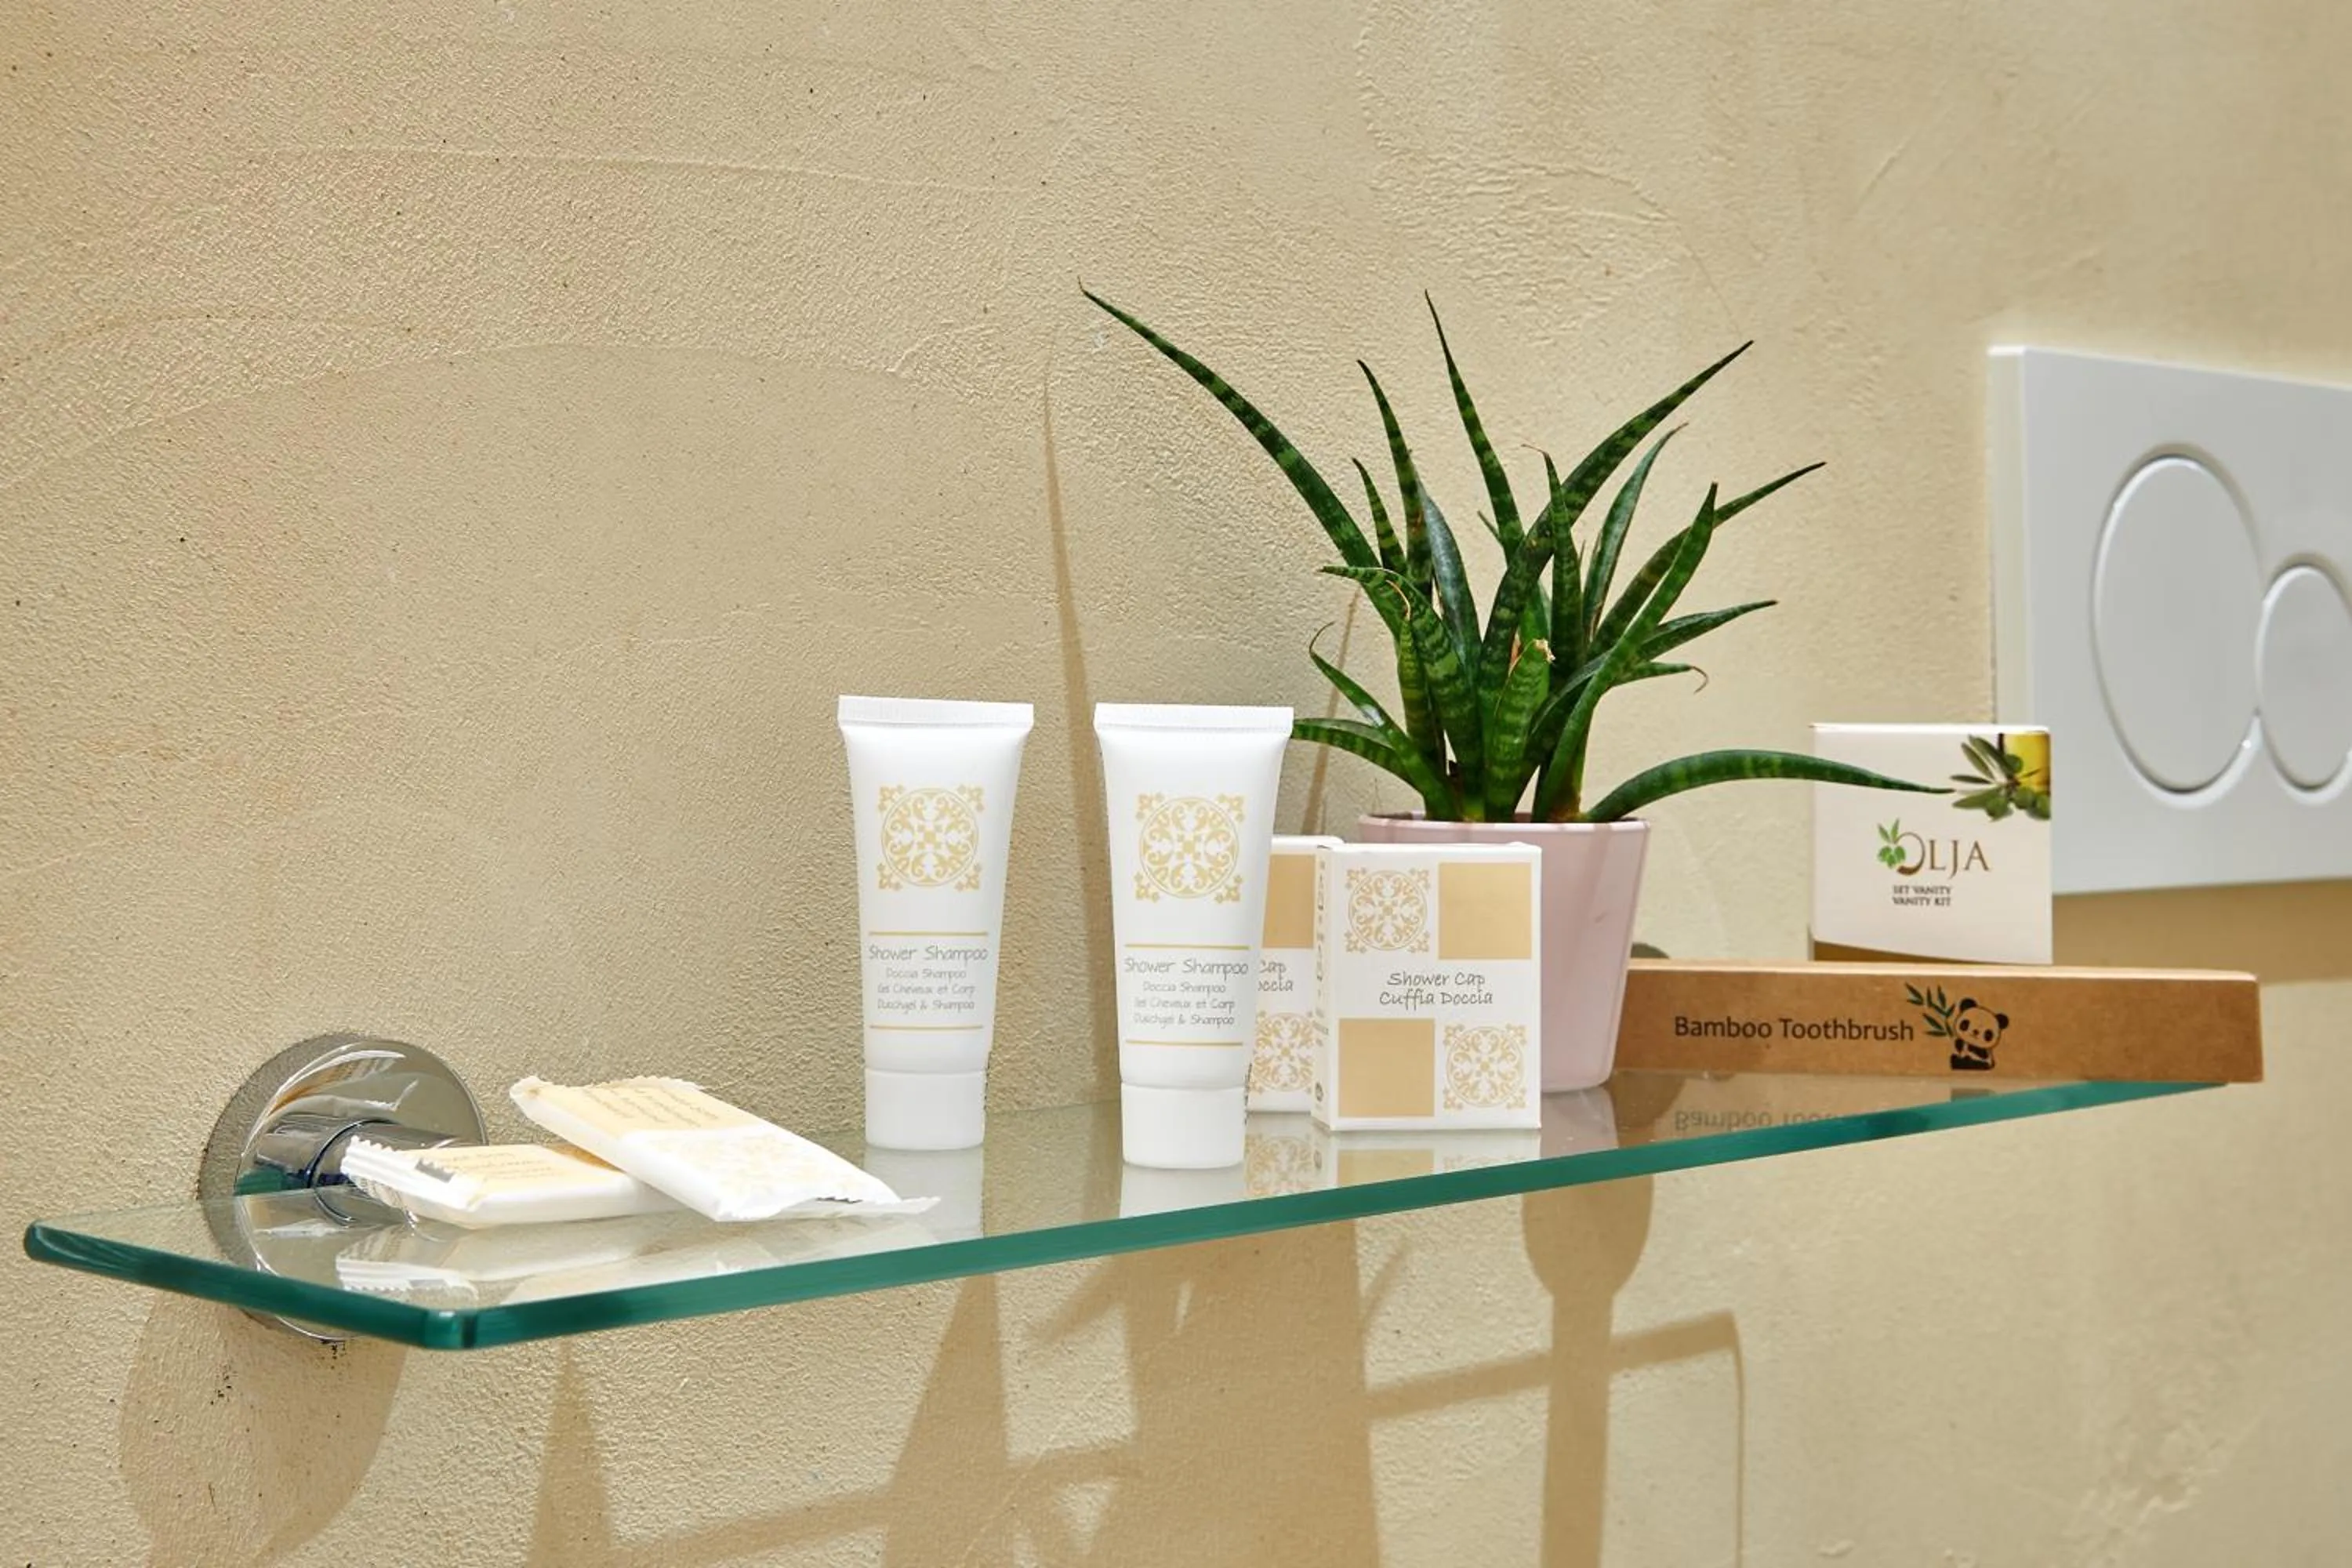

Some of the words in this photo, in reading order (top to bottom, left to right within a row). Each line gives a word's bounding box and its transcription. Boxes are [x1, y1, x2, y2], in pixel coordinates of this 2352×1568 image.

[1883, 831, 1990, 879] OLJA
[1911, 885, 1952, 895] VANITY
[1892, 896, 1931, 906] VANITY
[1934, 897, 1952, 906] KIT
[869, 944, 918, 961] Shower
[922, 945, 989, 966] Shampoo
[921, 968, 967, 983] Shampoo
[1123, 956, 1177, 974] Shower
[1181, 958, 1249, 981] Shampoo
[1142, 982, 1177, 993] Doccia
[1180, 982, 1227, 998] Shampoo
[1257, 979, 1294, 992] ccia
[1386, 971, 1450, 987] Shower
[1454, 971, 1486, 993] Cap
[931, 1000, 975, 1013] Shampoo
[1379, 988, 1436, 1011] Cuffia
[1440, 992, 1494, 1005] Doccia
[1190, 1014, 1236, 1029] Shampoo
[1674, 1016, 1773, 1039] Bamboo
[1777, 1018, 1915, 1042] Toothbrush
